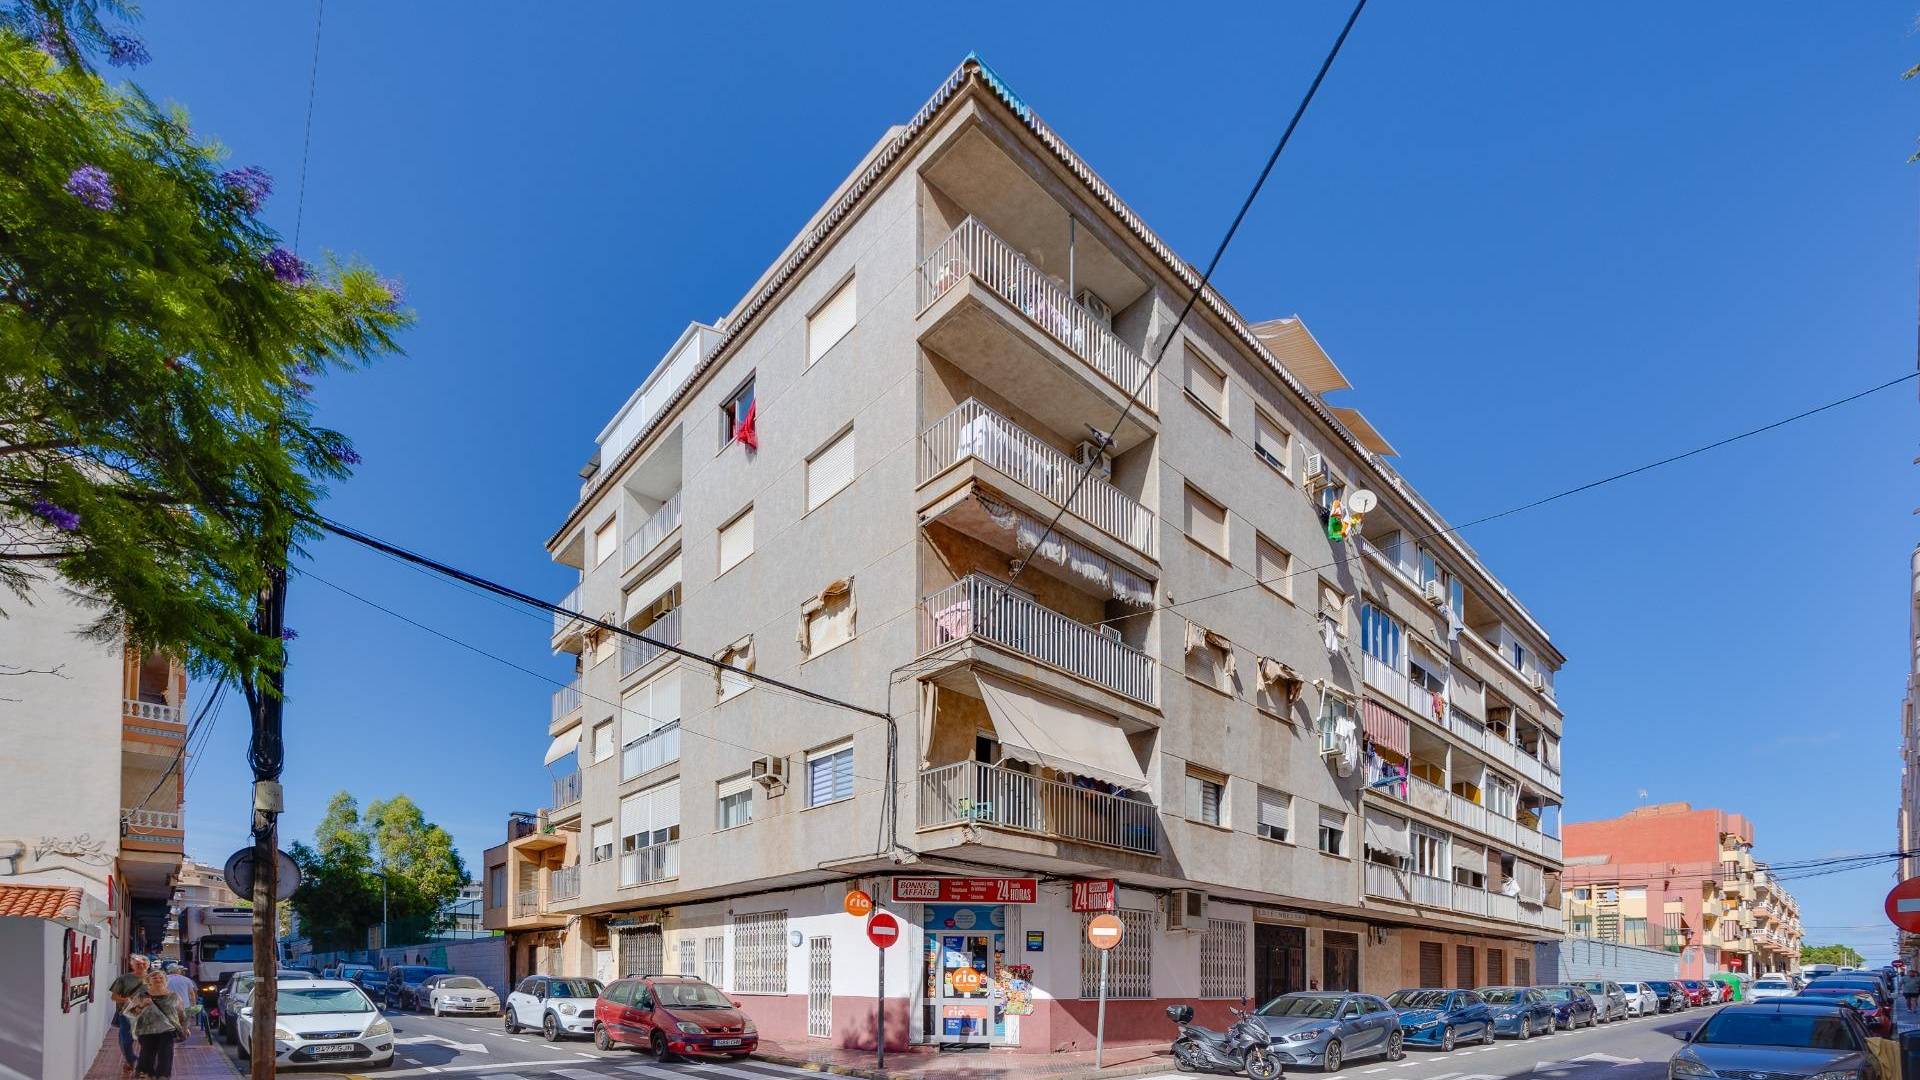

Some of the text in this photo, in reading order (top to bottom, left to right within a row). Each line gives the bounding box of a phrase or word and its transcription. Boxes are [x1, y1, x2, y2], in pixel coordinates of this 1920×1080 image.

[900, 881, 928, 889] BONNE
[997, 880, 1009, 900] 24
[902, 888, 937, 896] AFFAIRE
[1010, 888, 1031, 900] HORAS
[1075, 883, 1087, 910] 24
[850, 895, 869, 908] ria
[1088, 892, 1111, 909] HORAS
[955, 970, 976, 982] ria
[948, 1006, 965, 1016] ria
